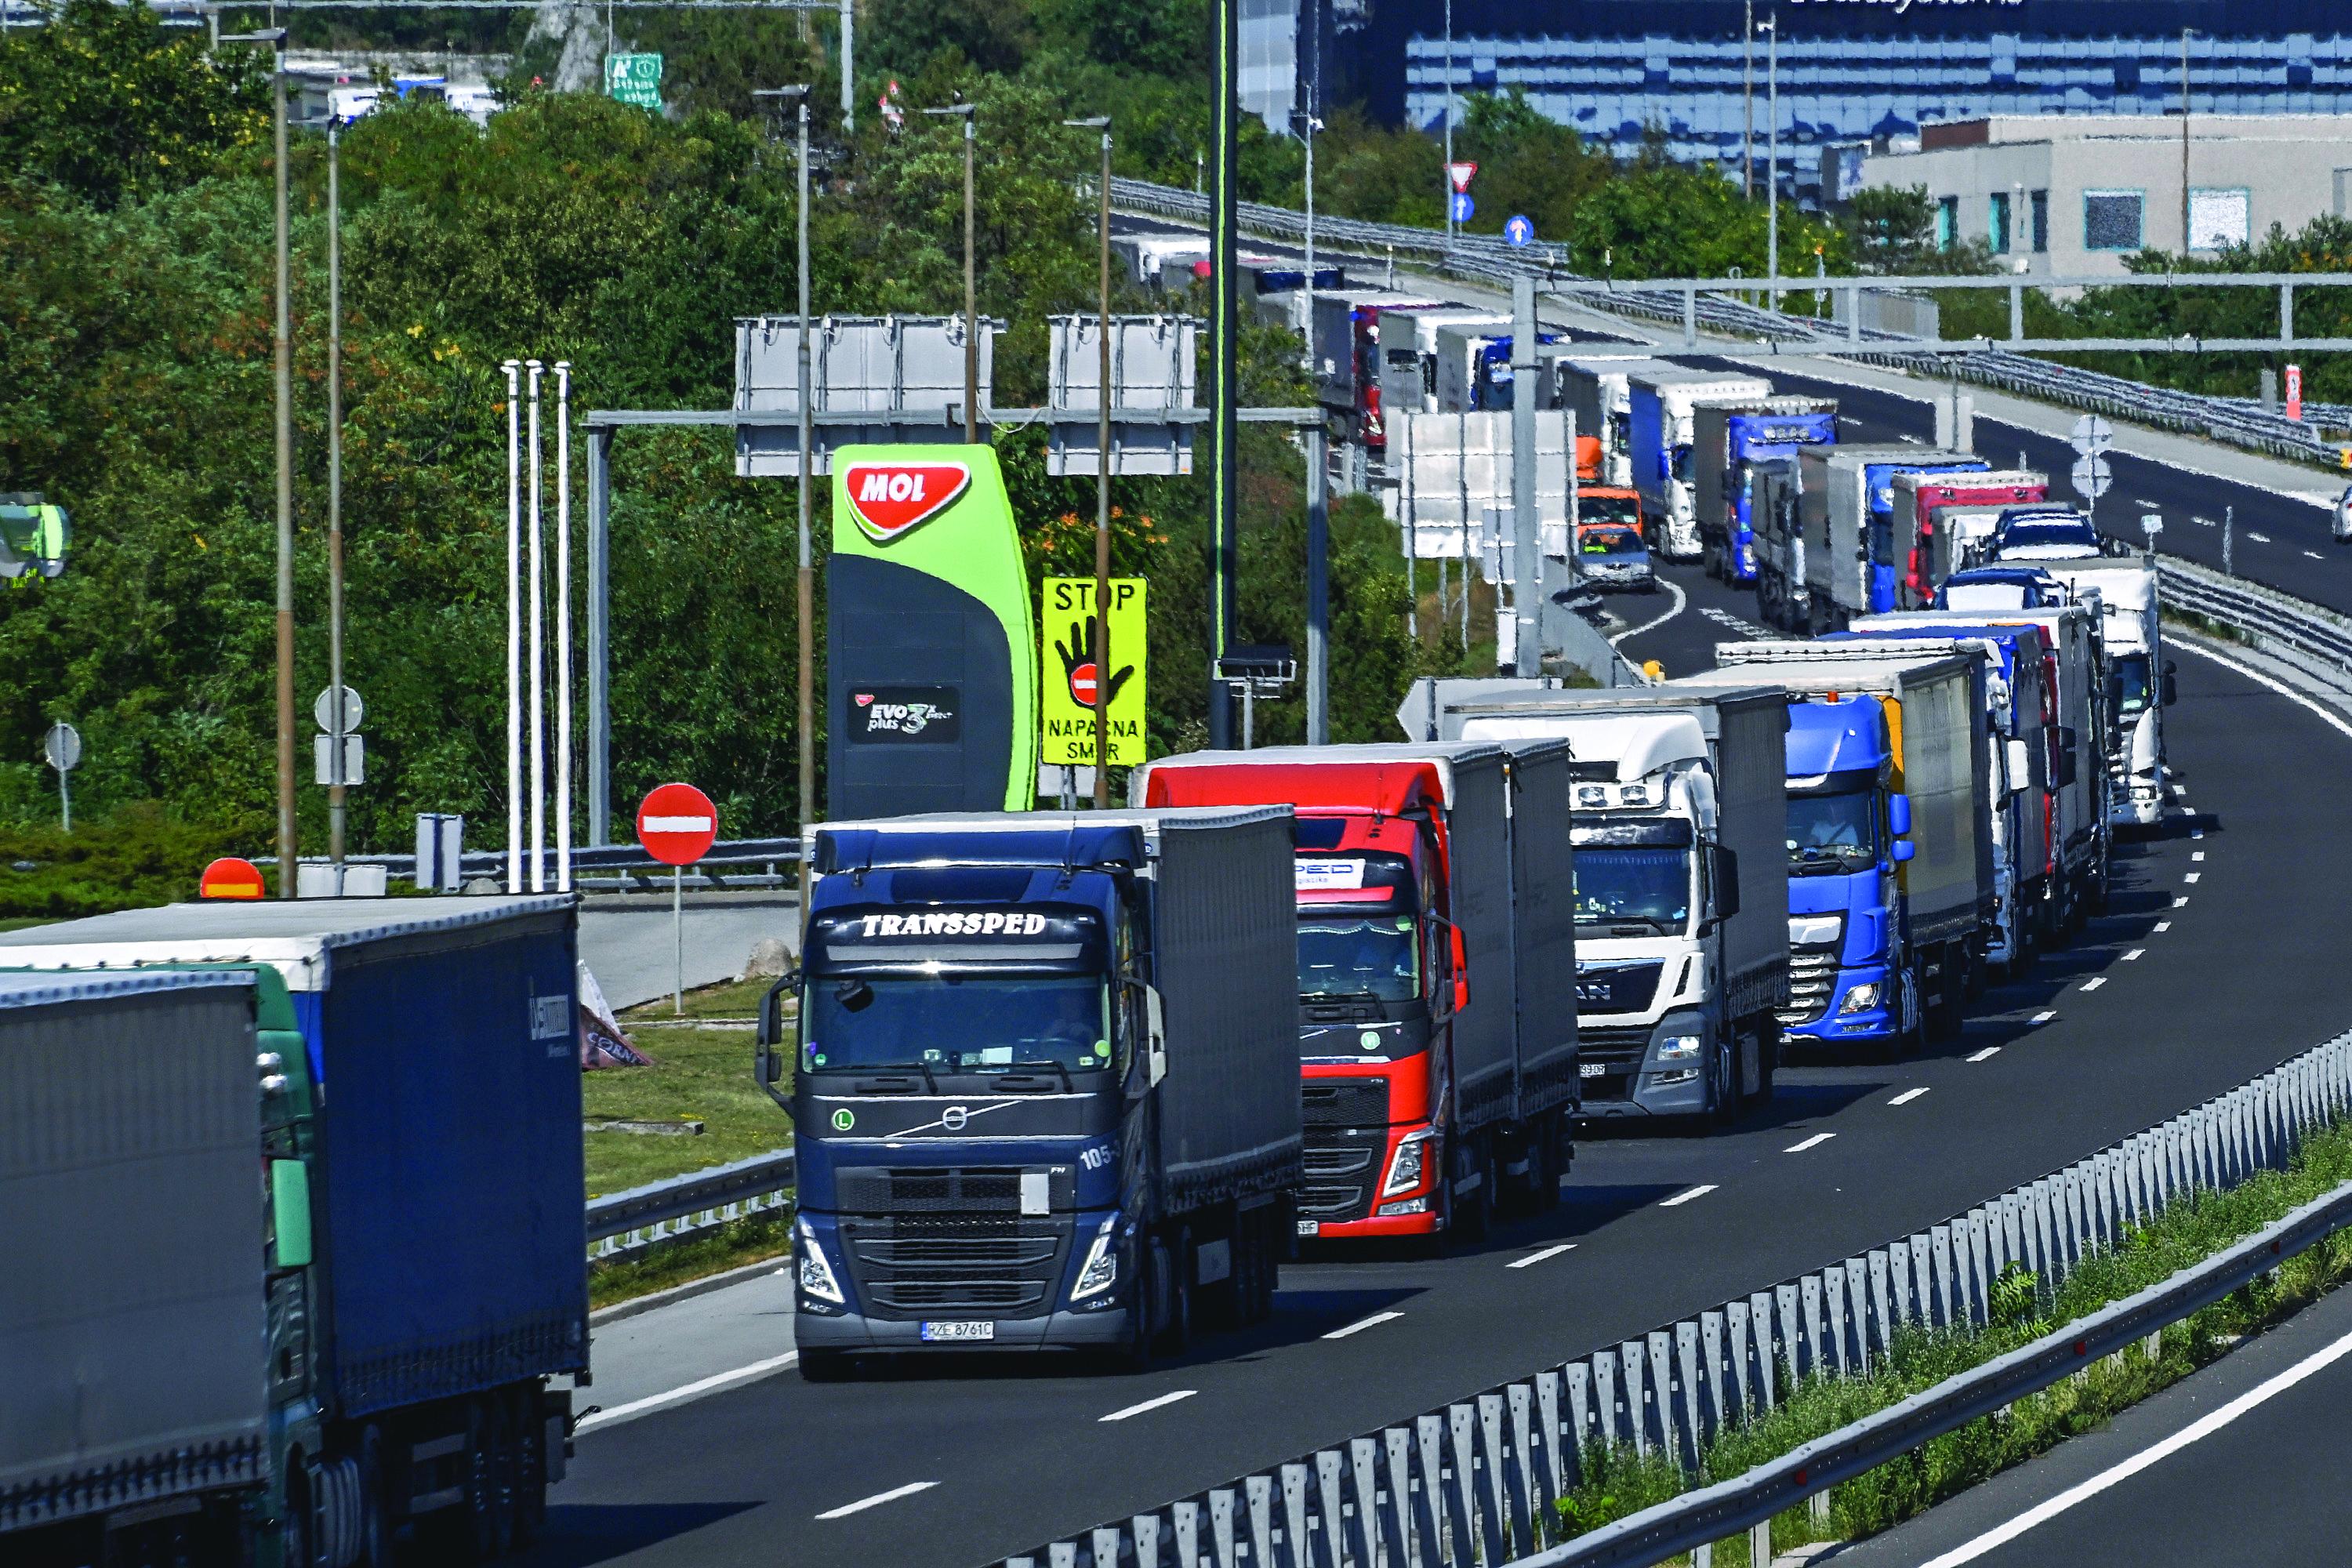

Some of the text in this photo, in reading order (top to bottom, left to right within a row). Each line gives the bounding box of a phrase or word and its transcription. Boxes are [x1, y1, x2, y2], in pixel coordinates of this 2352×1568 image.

[858, 473, 926, 502] MOL
[870, 704, 908, 719] EVO
[866, 716, 899, 732] plus
[1066, 742, 1120, 760] SMR
[862, 913, 1046, 937] TRANSSPED
[839, 1113, 849, 1127] L
